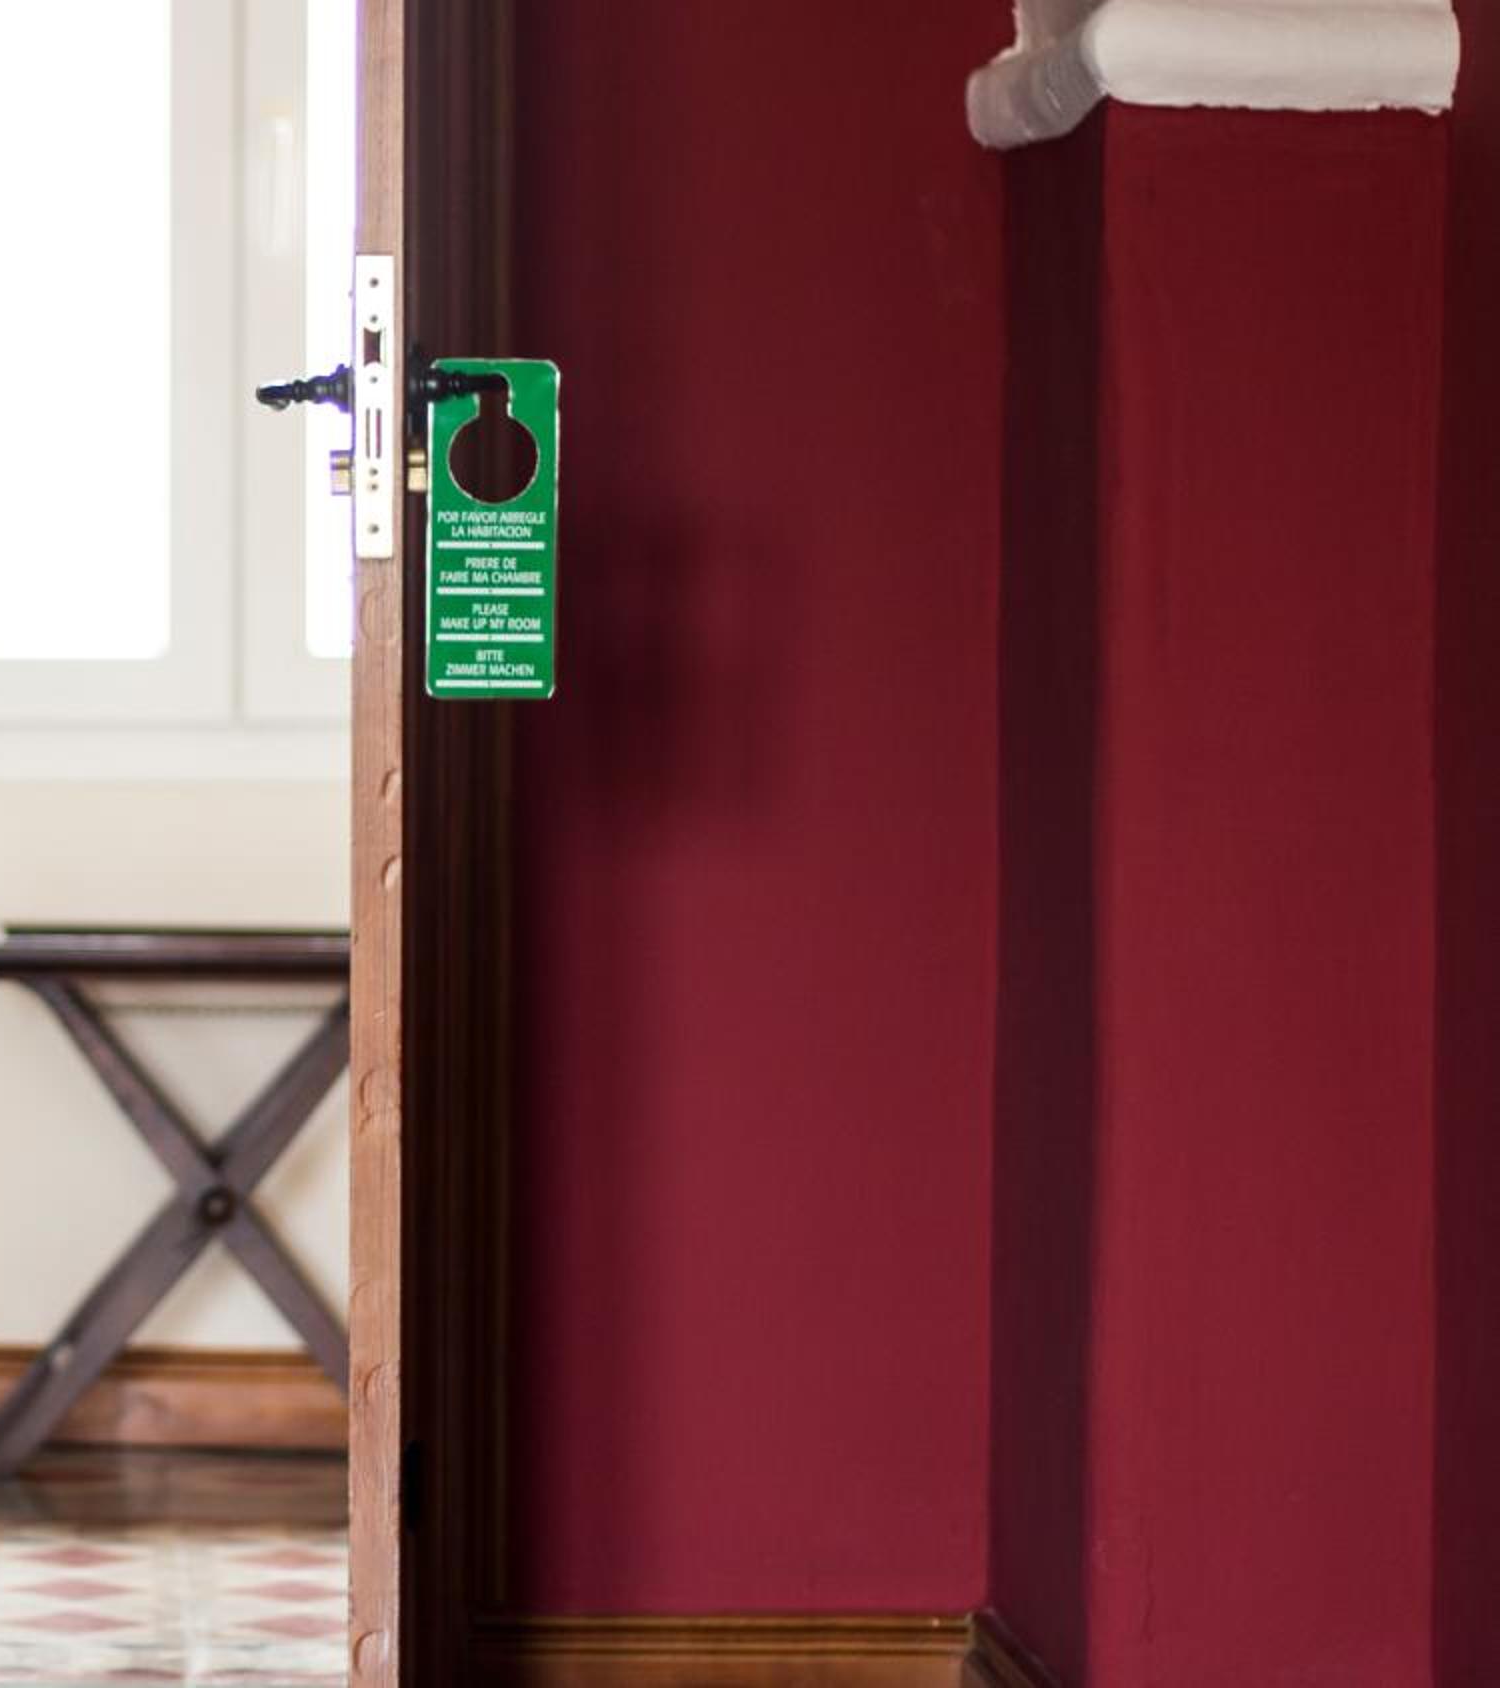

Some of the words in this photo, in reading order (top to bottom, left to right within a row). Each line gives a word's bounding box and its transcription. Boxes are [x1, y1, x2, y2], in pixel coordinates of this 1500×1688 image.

[437, 511, 460, 523] POR
[461, 511, 498, 524] FAVOR
[498, 511, 546, 524] ARREGLE
[451, 525, 465, 537] LA
[465, 557, 500, 570] PRIERE
[502, 557, 517, 570] DE
[439, 571, 469, 583] FAIRE
[471, 571, 489, 583] MA
[491, 571, 542, 584] CHAMBRE
[472, 603, 509, 616] PLEASE
[440, 617, 470, 630] MAKE
[472, 617, 488, 630] UP
[489, 617, 505, 629] MY
[507, 617, 541, 631] ROOM
[475, 649, 504, 662] BITTE
[445, 663, 487, 676] ZIMMER
[488, 663, 535, 676] MACHEN
